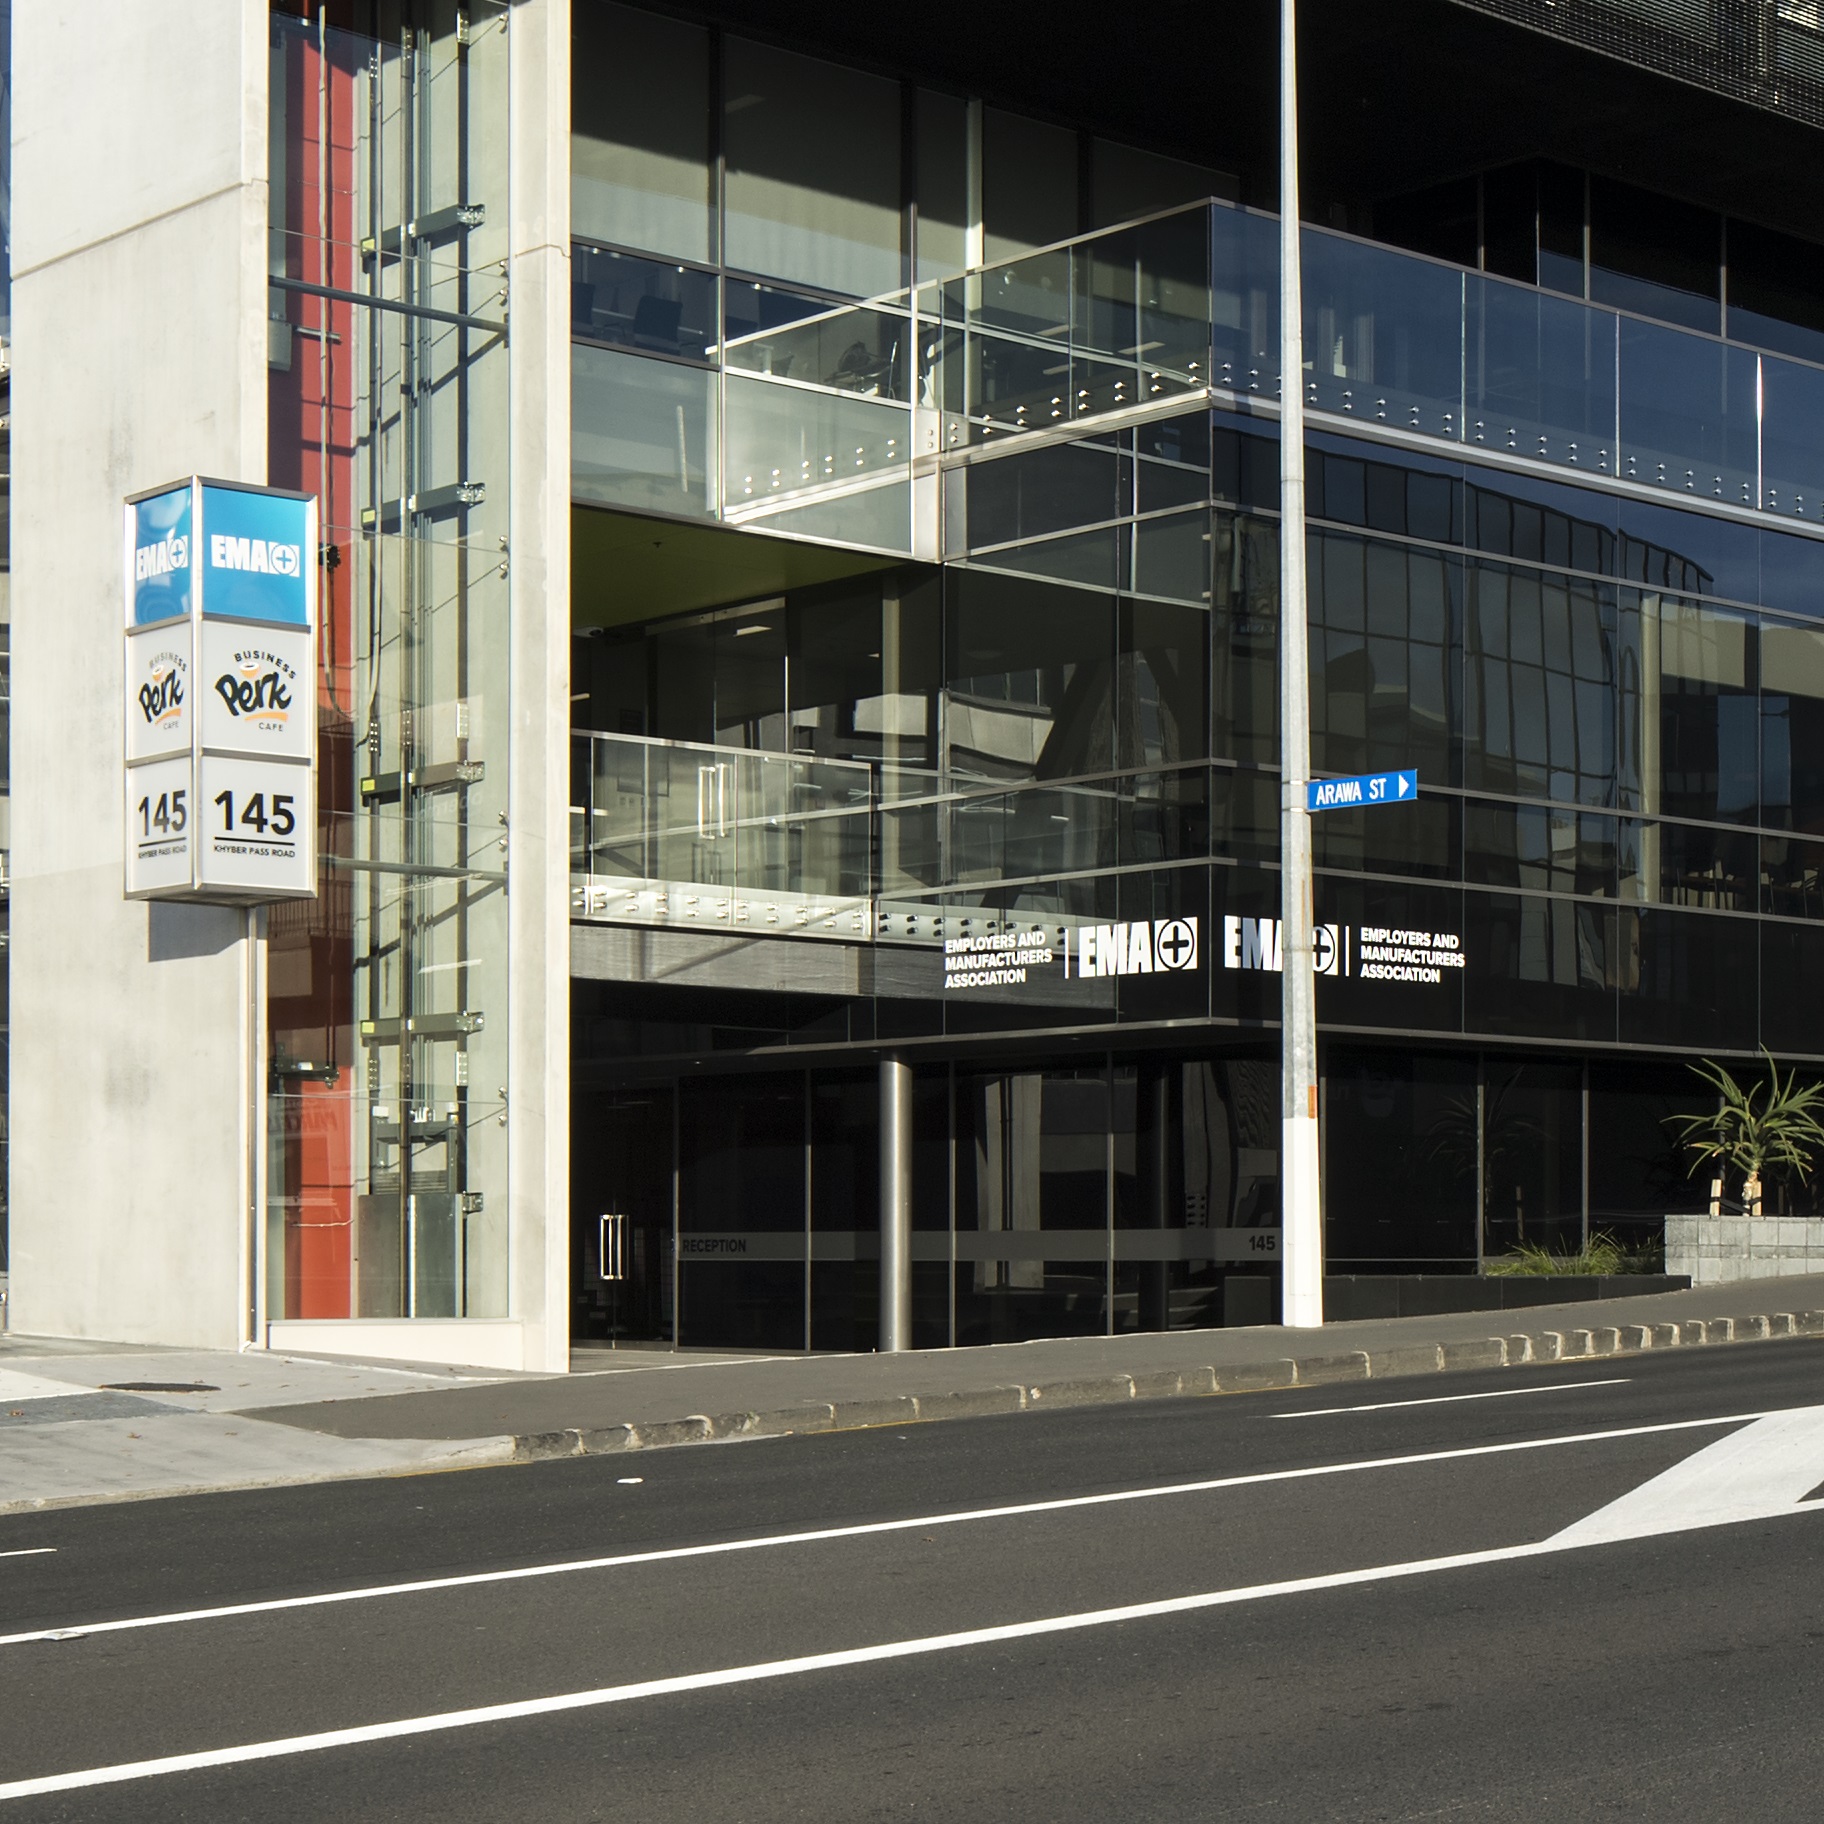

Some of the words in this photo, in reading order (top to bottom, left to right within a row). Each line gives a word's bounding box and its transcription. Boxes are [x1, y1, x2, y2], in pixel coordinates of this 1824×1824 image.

[136, 539, 167, 581] EMA
[211, 534, 269, 573] EMA
[149, 652, 188, 673] BUSINESS
[233, 649, 297, 680] BUSINESS
[138, 668, 185, 723] Perk
[214, 671, 293, 717] Perk
[163, 721, 179, 730] CAFE
[258, 721, 284, 732] CAFE
[1315, 780, 1363, 806] ARAWA
[1368, 777, 1388, 800] ST
[138, 789, 187, 837] 145
[214, 789, 296, 836] 145
[213, 844, 247, 855] KHYBER
[249, 847, 270, 857] PASS
[271, 848, 296, 859] ROAD
[945, 933, 1016, 954] EMPLOYERS
[1017, 931, 1046, 948] AND
[1078, 920, 1153, 979] EMA
[1360, 926, 1432, 947] EMPLOYERS
[1432, 933, 1460, 950] AND
[945, 948, 1053, 972] MANUFACTURERS
[1360, 944, 1466, 968] MANUFACTURERS
[944, 968, 1026, 989] ASSOCIATION
[1360, 963, 1441, 984] ASSOCIATION
[682, 1239, 747, 1253] RECEPTION
[1248, 1235, 1276, 1251] 145
